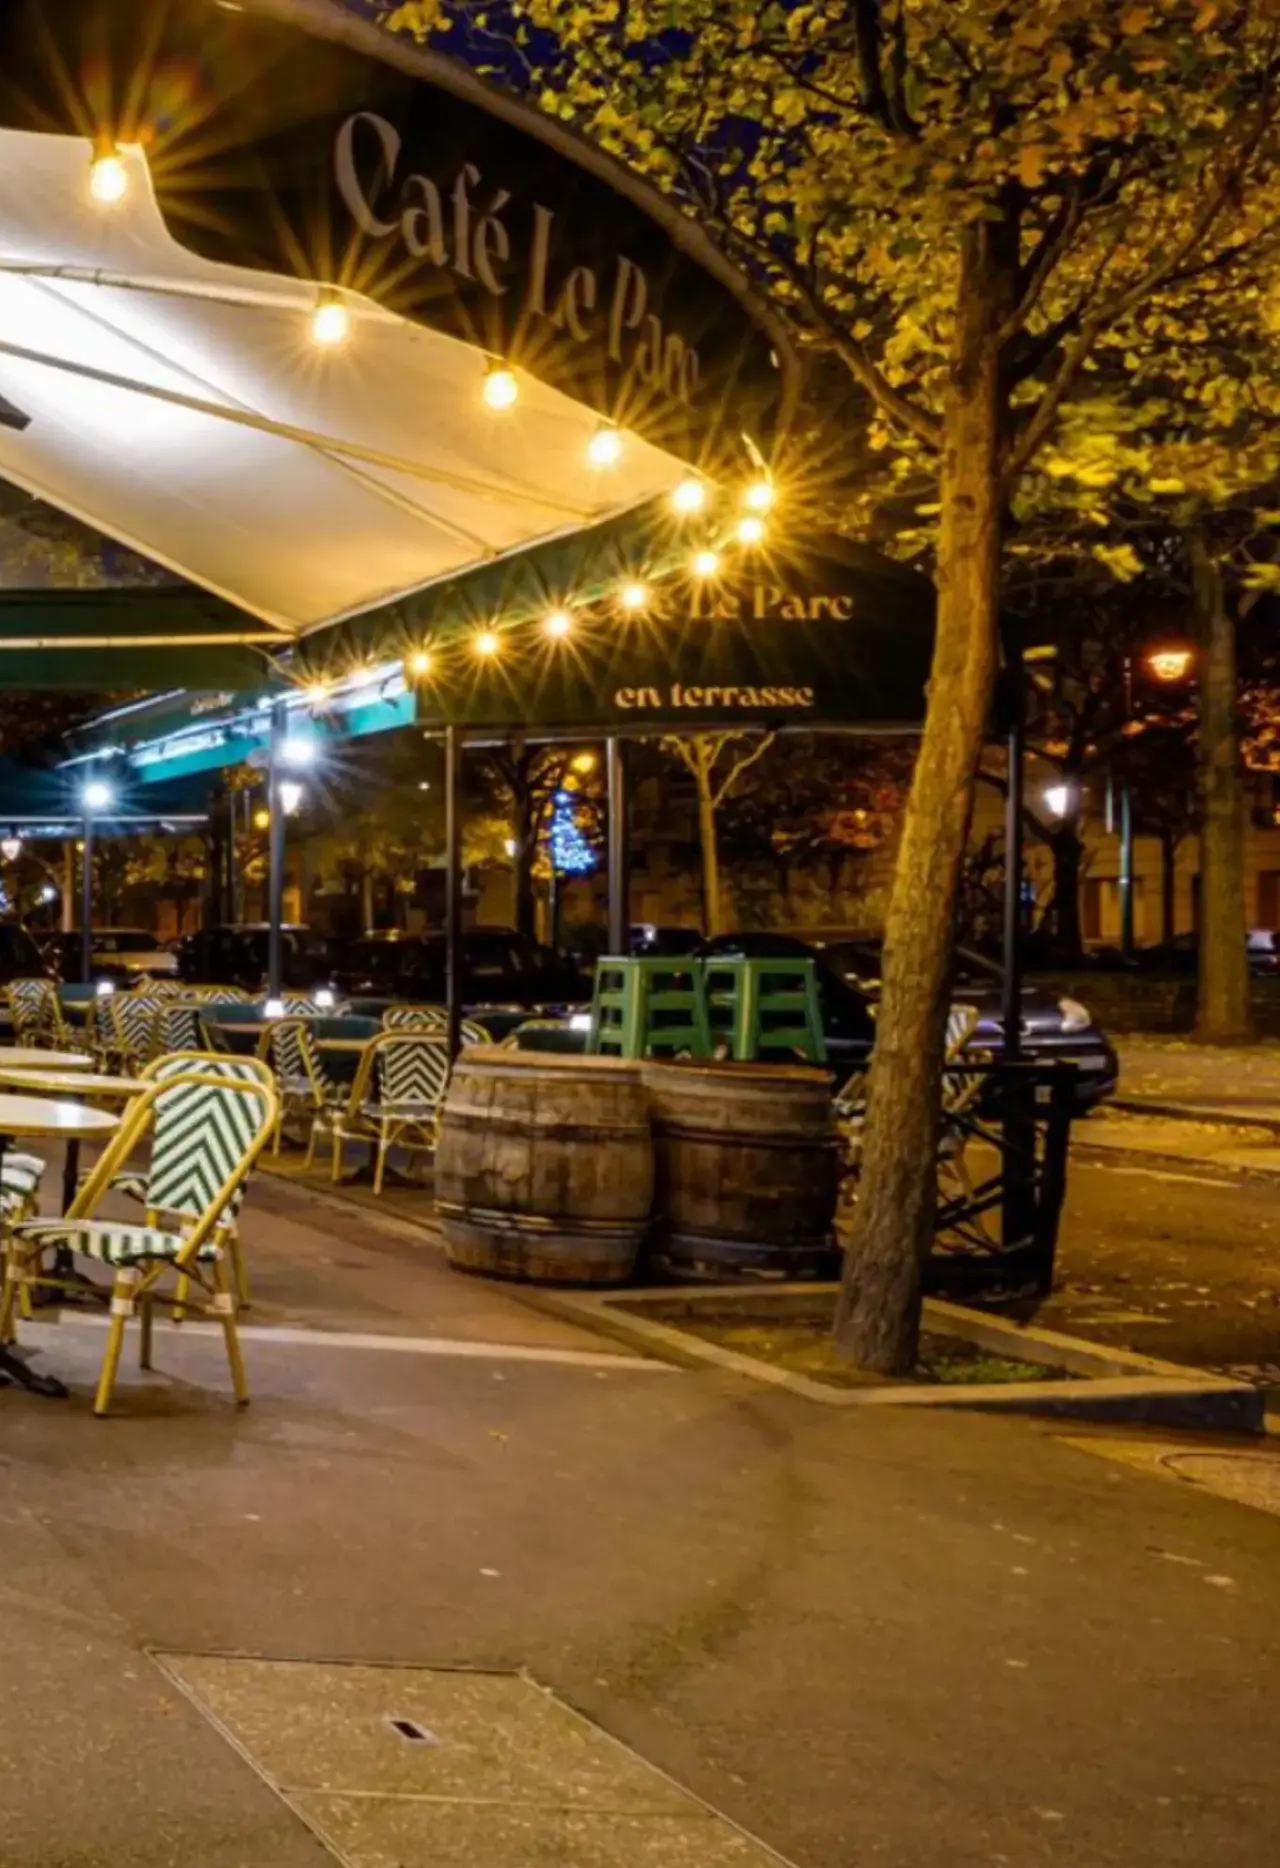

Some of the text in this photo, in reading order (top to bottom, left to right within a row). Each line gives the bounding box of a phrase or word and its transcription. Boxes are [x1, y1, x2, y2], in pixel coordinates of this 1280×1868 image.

[335, 111, 511, 296] Café
[527, 200, 597, 342] Le
[690, 584, 739, 620] Le
[753, 585, 854, 620] Parc
[614, 682, 815, 708] en terrasse
